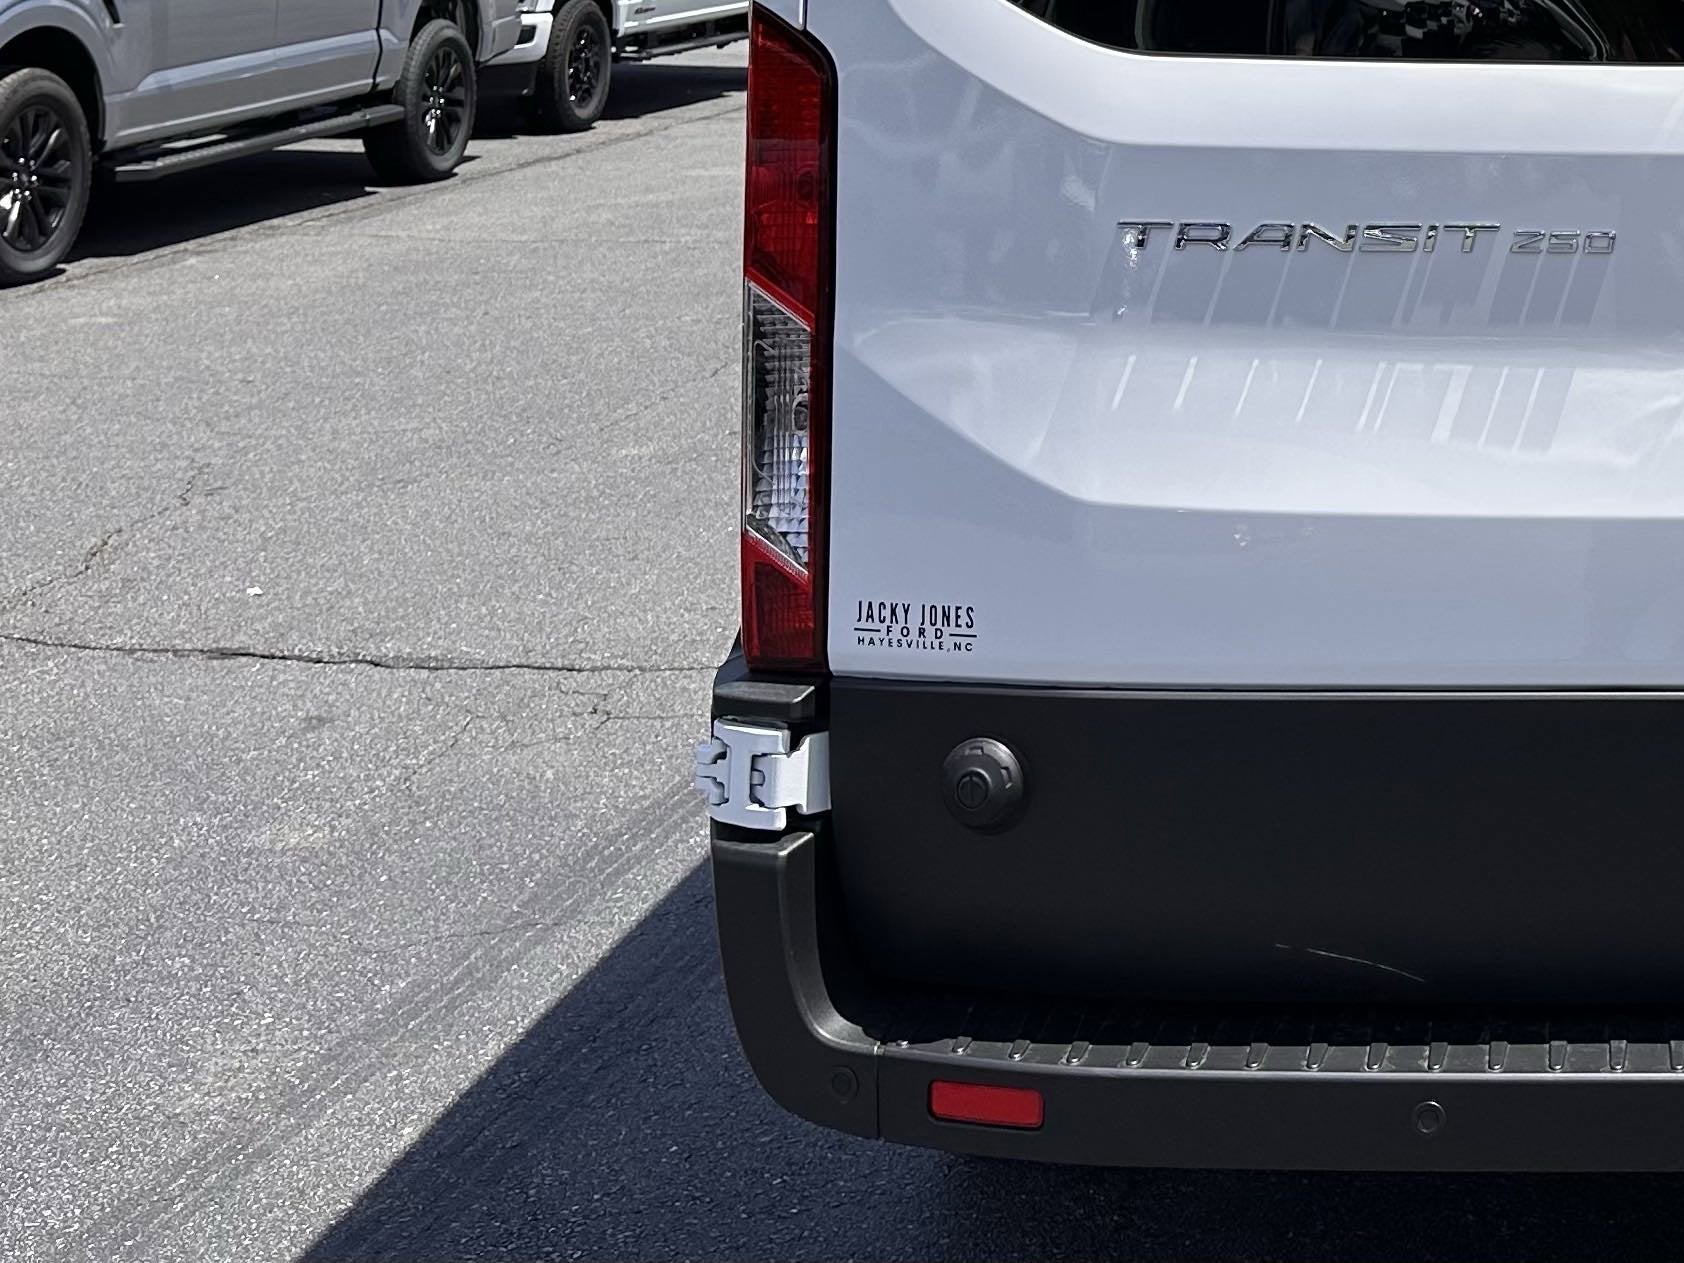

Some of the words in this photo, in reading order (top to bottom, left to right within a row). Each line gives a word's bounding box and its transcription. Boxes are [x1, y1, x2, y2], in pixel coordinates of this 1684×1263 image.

[1116, 220, 1501, 253] TRANSIT
[1509, 230, 1617, 255] 250
[856, 600, 911, 625] JACKY
[919, 603, 975, 629] JONES
[886, 625, 944, 640] FORD
